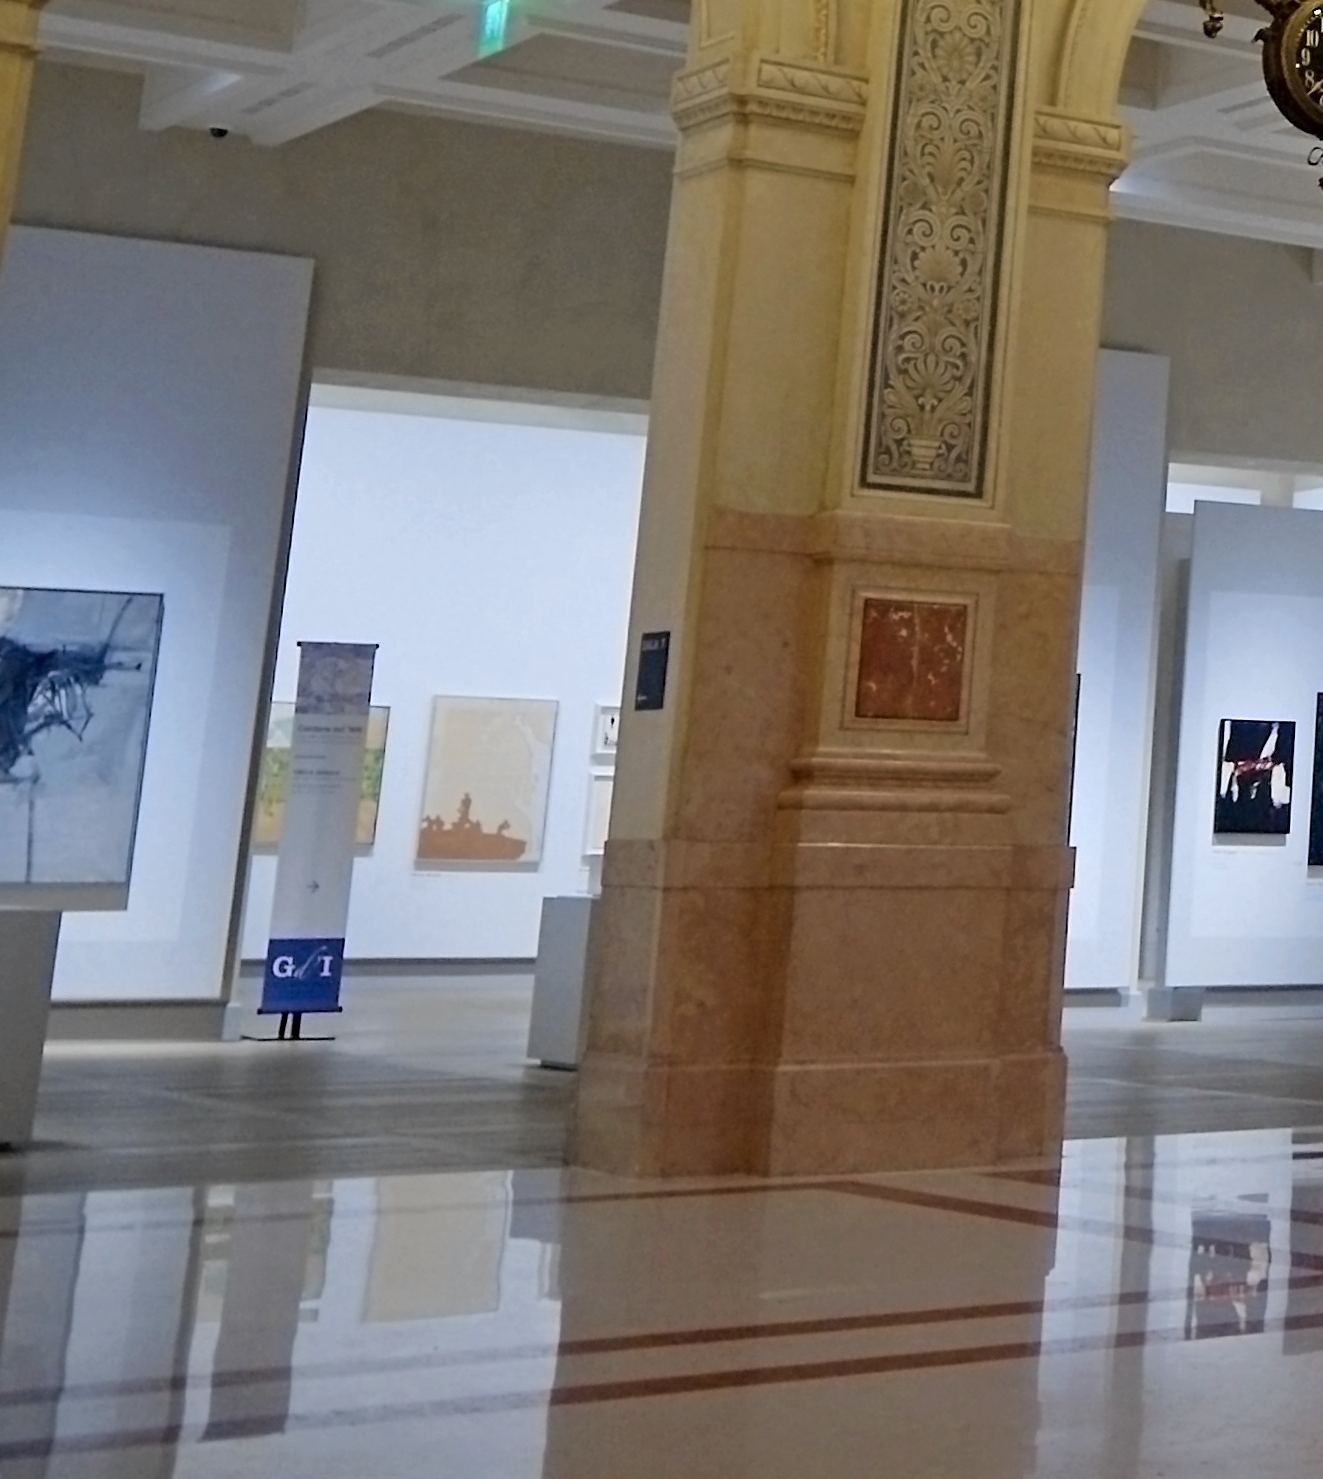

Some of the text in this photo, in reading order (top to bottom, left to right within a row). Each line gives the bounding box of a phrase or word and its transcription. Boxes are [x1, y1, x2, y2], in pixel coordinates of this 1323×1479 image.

[1305, 29, 1320, 48] 10
[1300, 47, 1311, 66] 9
[1304, 69, 1315, 88] 8
